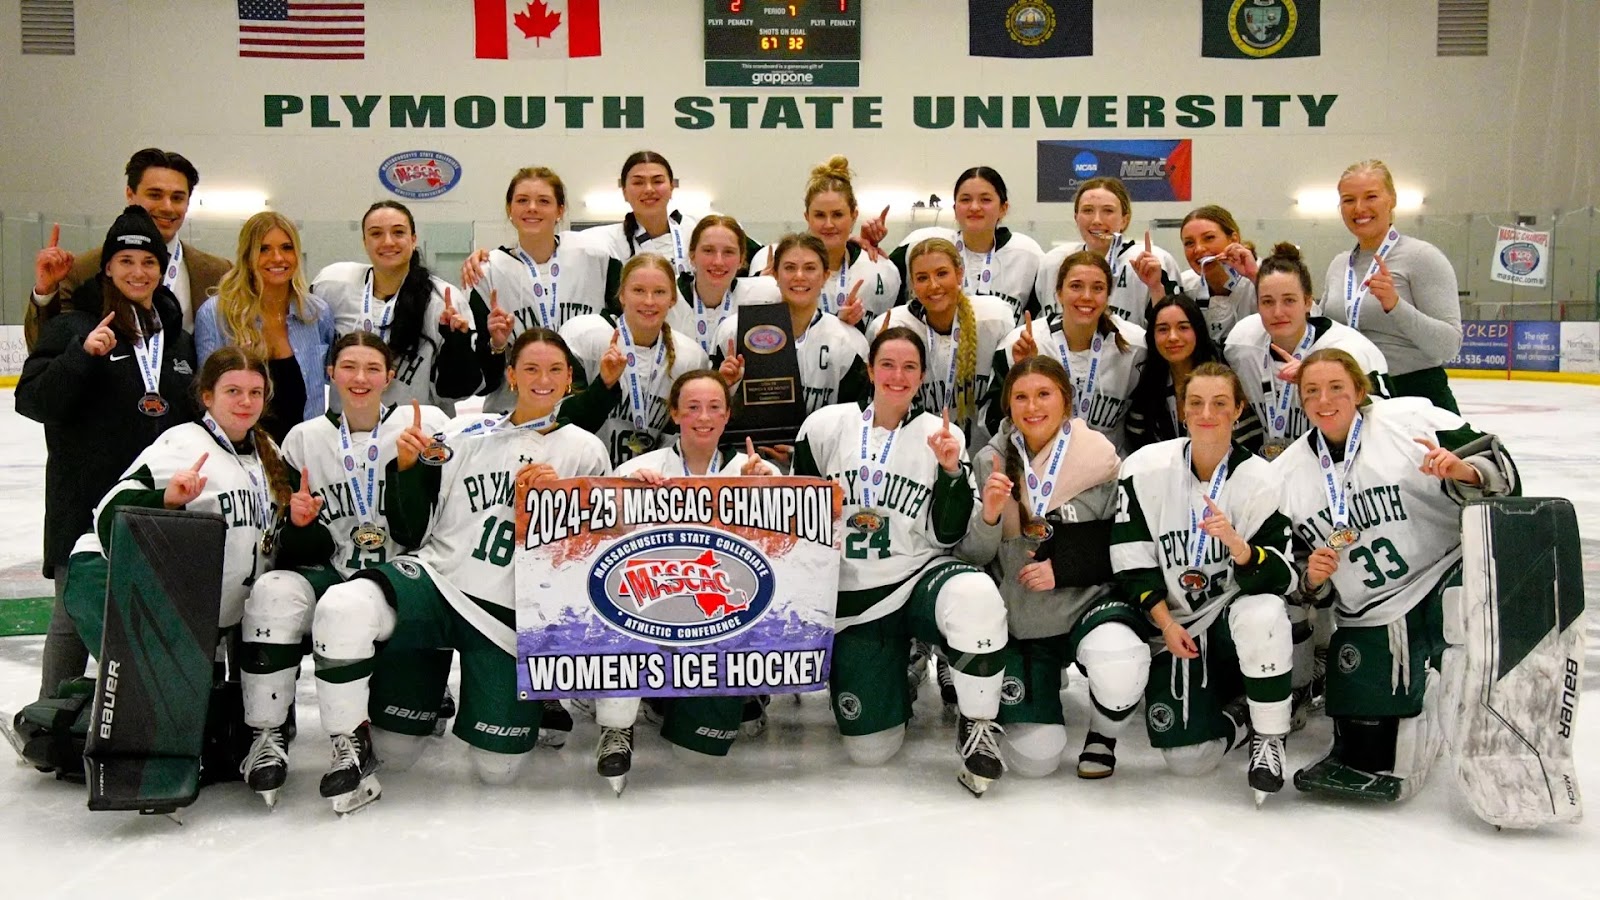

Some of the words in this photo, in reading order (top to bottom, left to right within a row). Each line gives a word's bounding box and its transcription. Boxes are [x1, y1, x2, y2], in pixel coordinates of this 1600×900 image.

[761, 37, 778, 50] 67
[789, 37, 804, 50] 32
[752, 72, 813, 84] grappone
[263, 95, 643, 128] PLYMOUTH
[675, 96, 881, 128] STATE
[914, 95, 1338, 128] UNIVERSITY
[1074, 163, 1097, 171] NCAA
[1119, 160, 1166, 176] NEHC
[876, 273, 884, 295] A
[1117, 265, 1127, 288] A
[1497, 272, 1538, 284] mascac.com
[1462, 323, 1508, 338] CKED
[1524, 331, 1536, 340] The
[1536, 333, 1549, 343] right
[141, 355, 156, 391] mascac.com
[819, 345, 829, 370] C
[1446, 355, 1505, 364] 3-536-4000
[351, 477, 367, 516] mascac.com
[1210, 464, 1227, 500] mascac.com
[525, 487, 617, 550] 2024-25
[624, 486, 713, 525] MASCAC
[719, 485, 833, 547] CHAMPION
[471, 515, 516, 567] 18
[846, 515, 891, 559] 24
[594, 532, 675, 579] MASSACHUSETTS
[680, 532, 711, 545] STATE
[716, 537, 769, 578] COLLEGIATE
[1349, 536, 1409, 588] 33
[627, 562, 731, 606] MASCAC
[624, 617, 672, 638] ATHLETIC
[677, 615, 742, 639] CONFERENCE
[527, 652, 665, 691] WOMEN'S
[672, 652, 718, 688] ICE
[727, 649, 826, 687] HOCKEY
[100, 659, 121, 739] BAUER
[1558, 657, 1578, 739] BAUER
[1563, 774, 1576, 806] MACH
